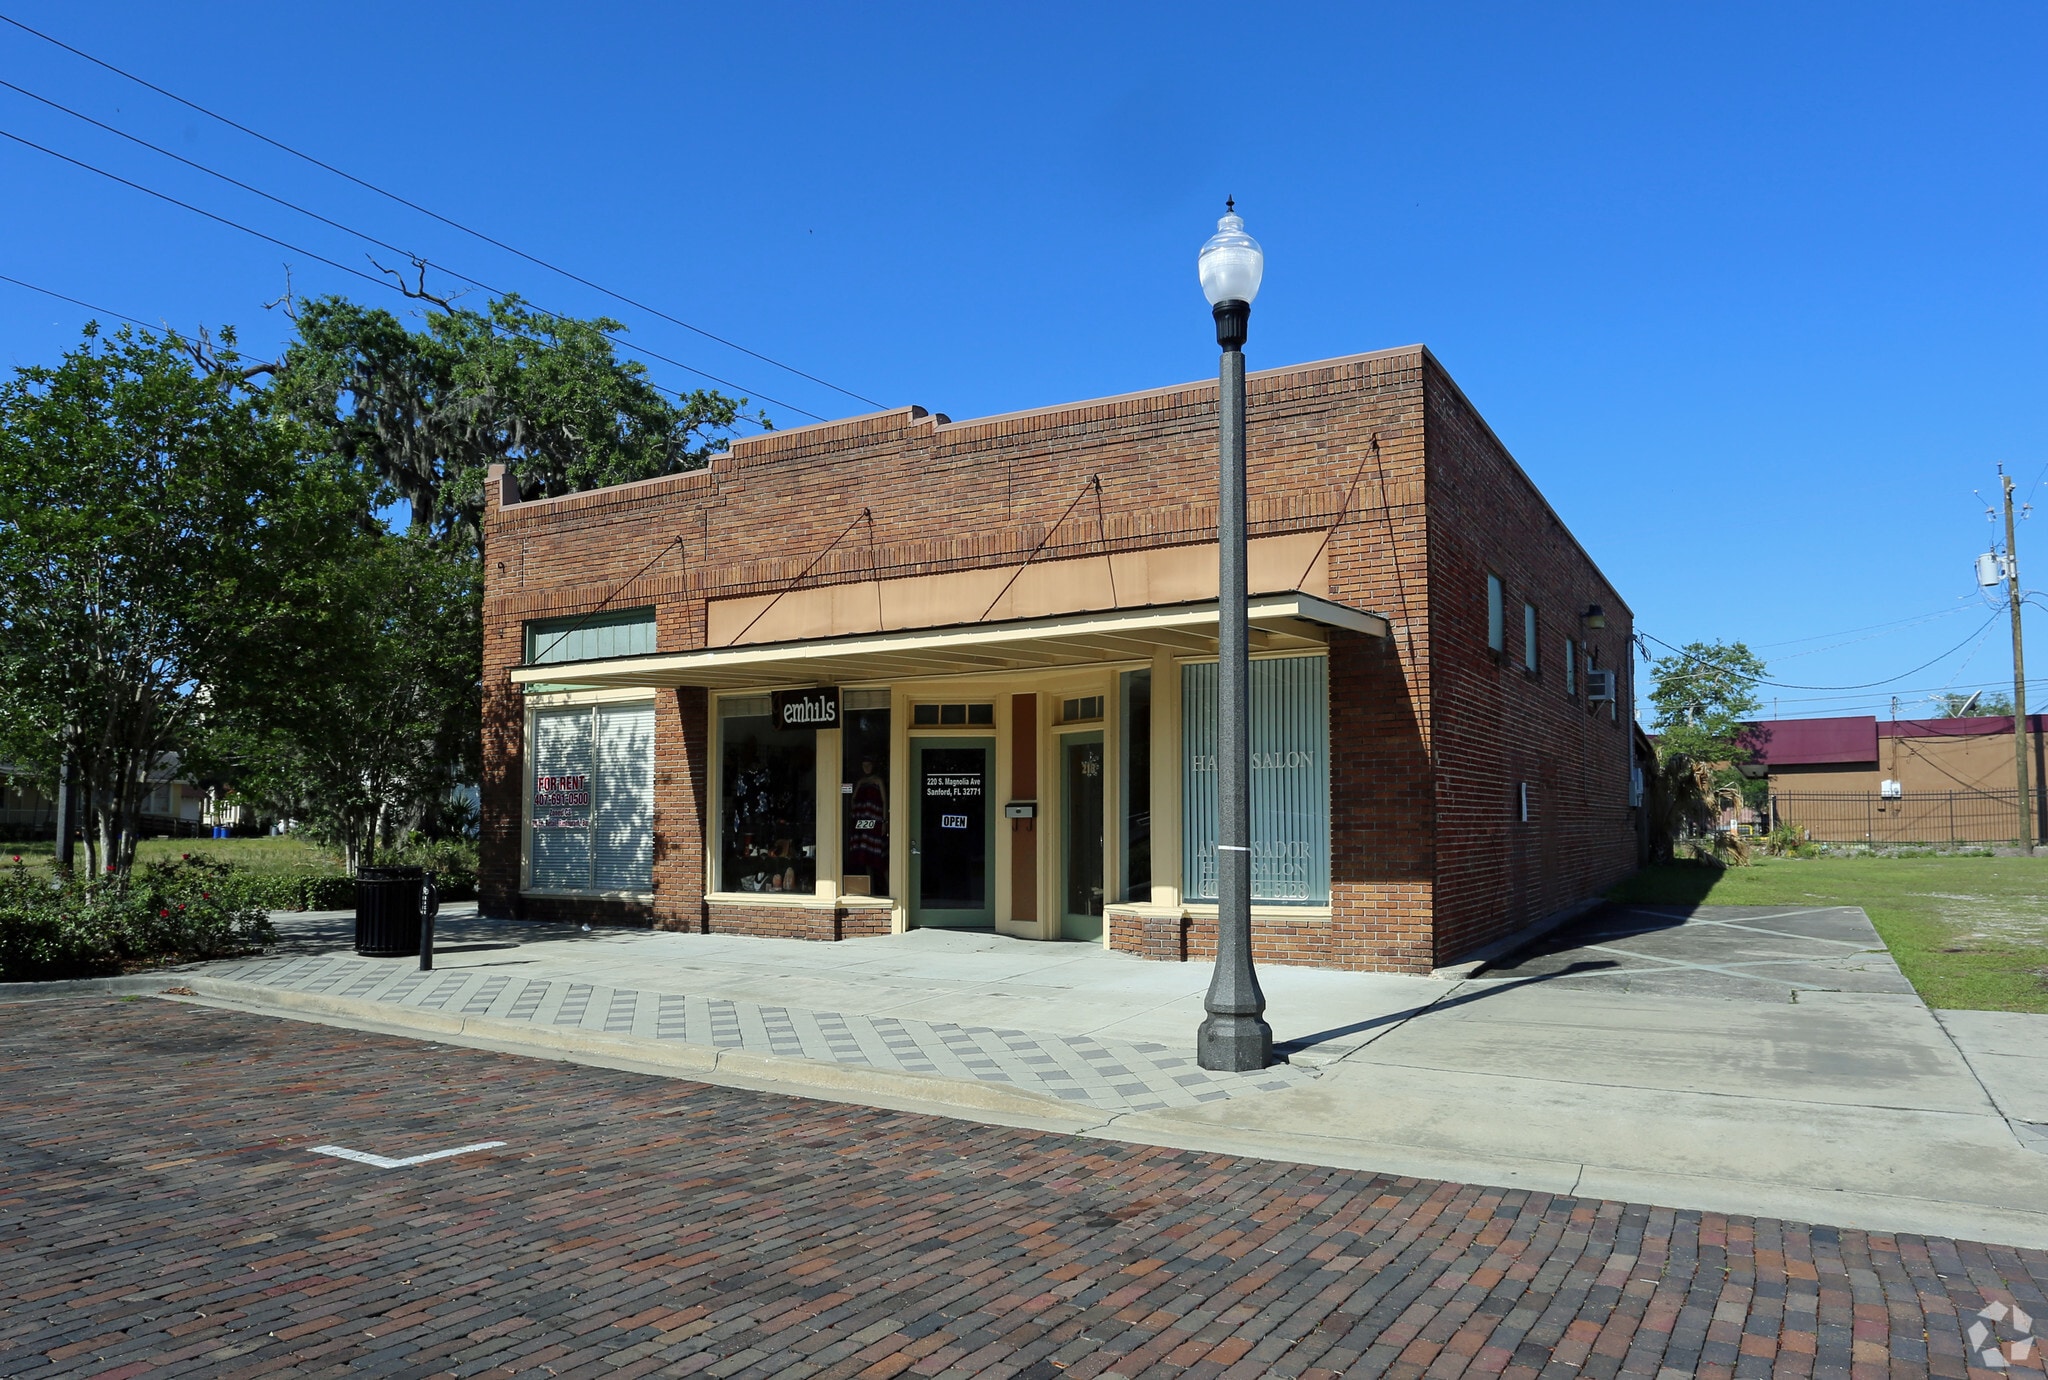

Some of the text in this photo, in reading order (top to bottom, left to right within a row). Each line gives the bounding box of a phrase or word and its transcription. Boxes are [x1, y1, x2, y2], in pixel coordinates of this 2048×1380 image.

[1252, 751, 1313, 768] SALON
[538, 775, 585, 791] FOR RENT
[945, 778, 969, 787] Magnolia
[927, 788, 952, 797] Sanford,
[535, 793, 588, 805] 407-691-0500
[857, 820, 875, 828] 220
[943, 816, 966, 827] OPEN
[1251, 862, 1307, 876] SALON
